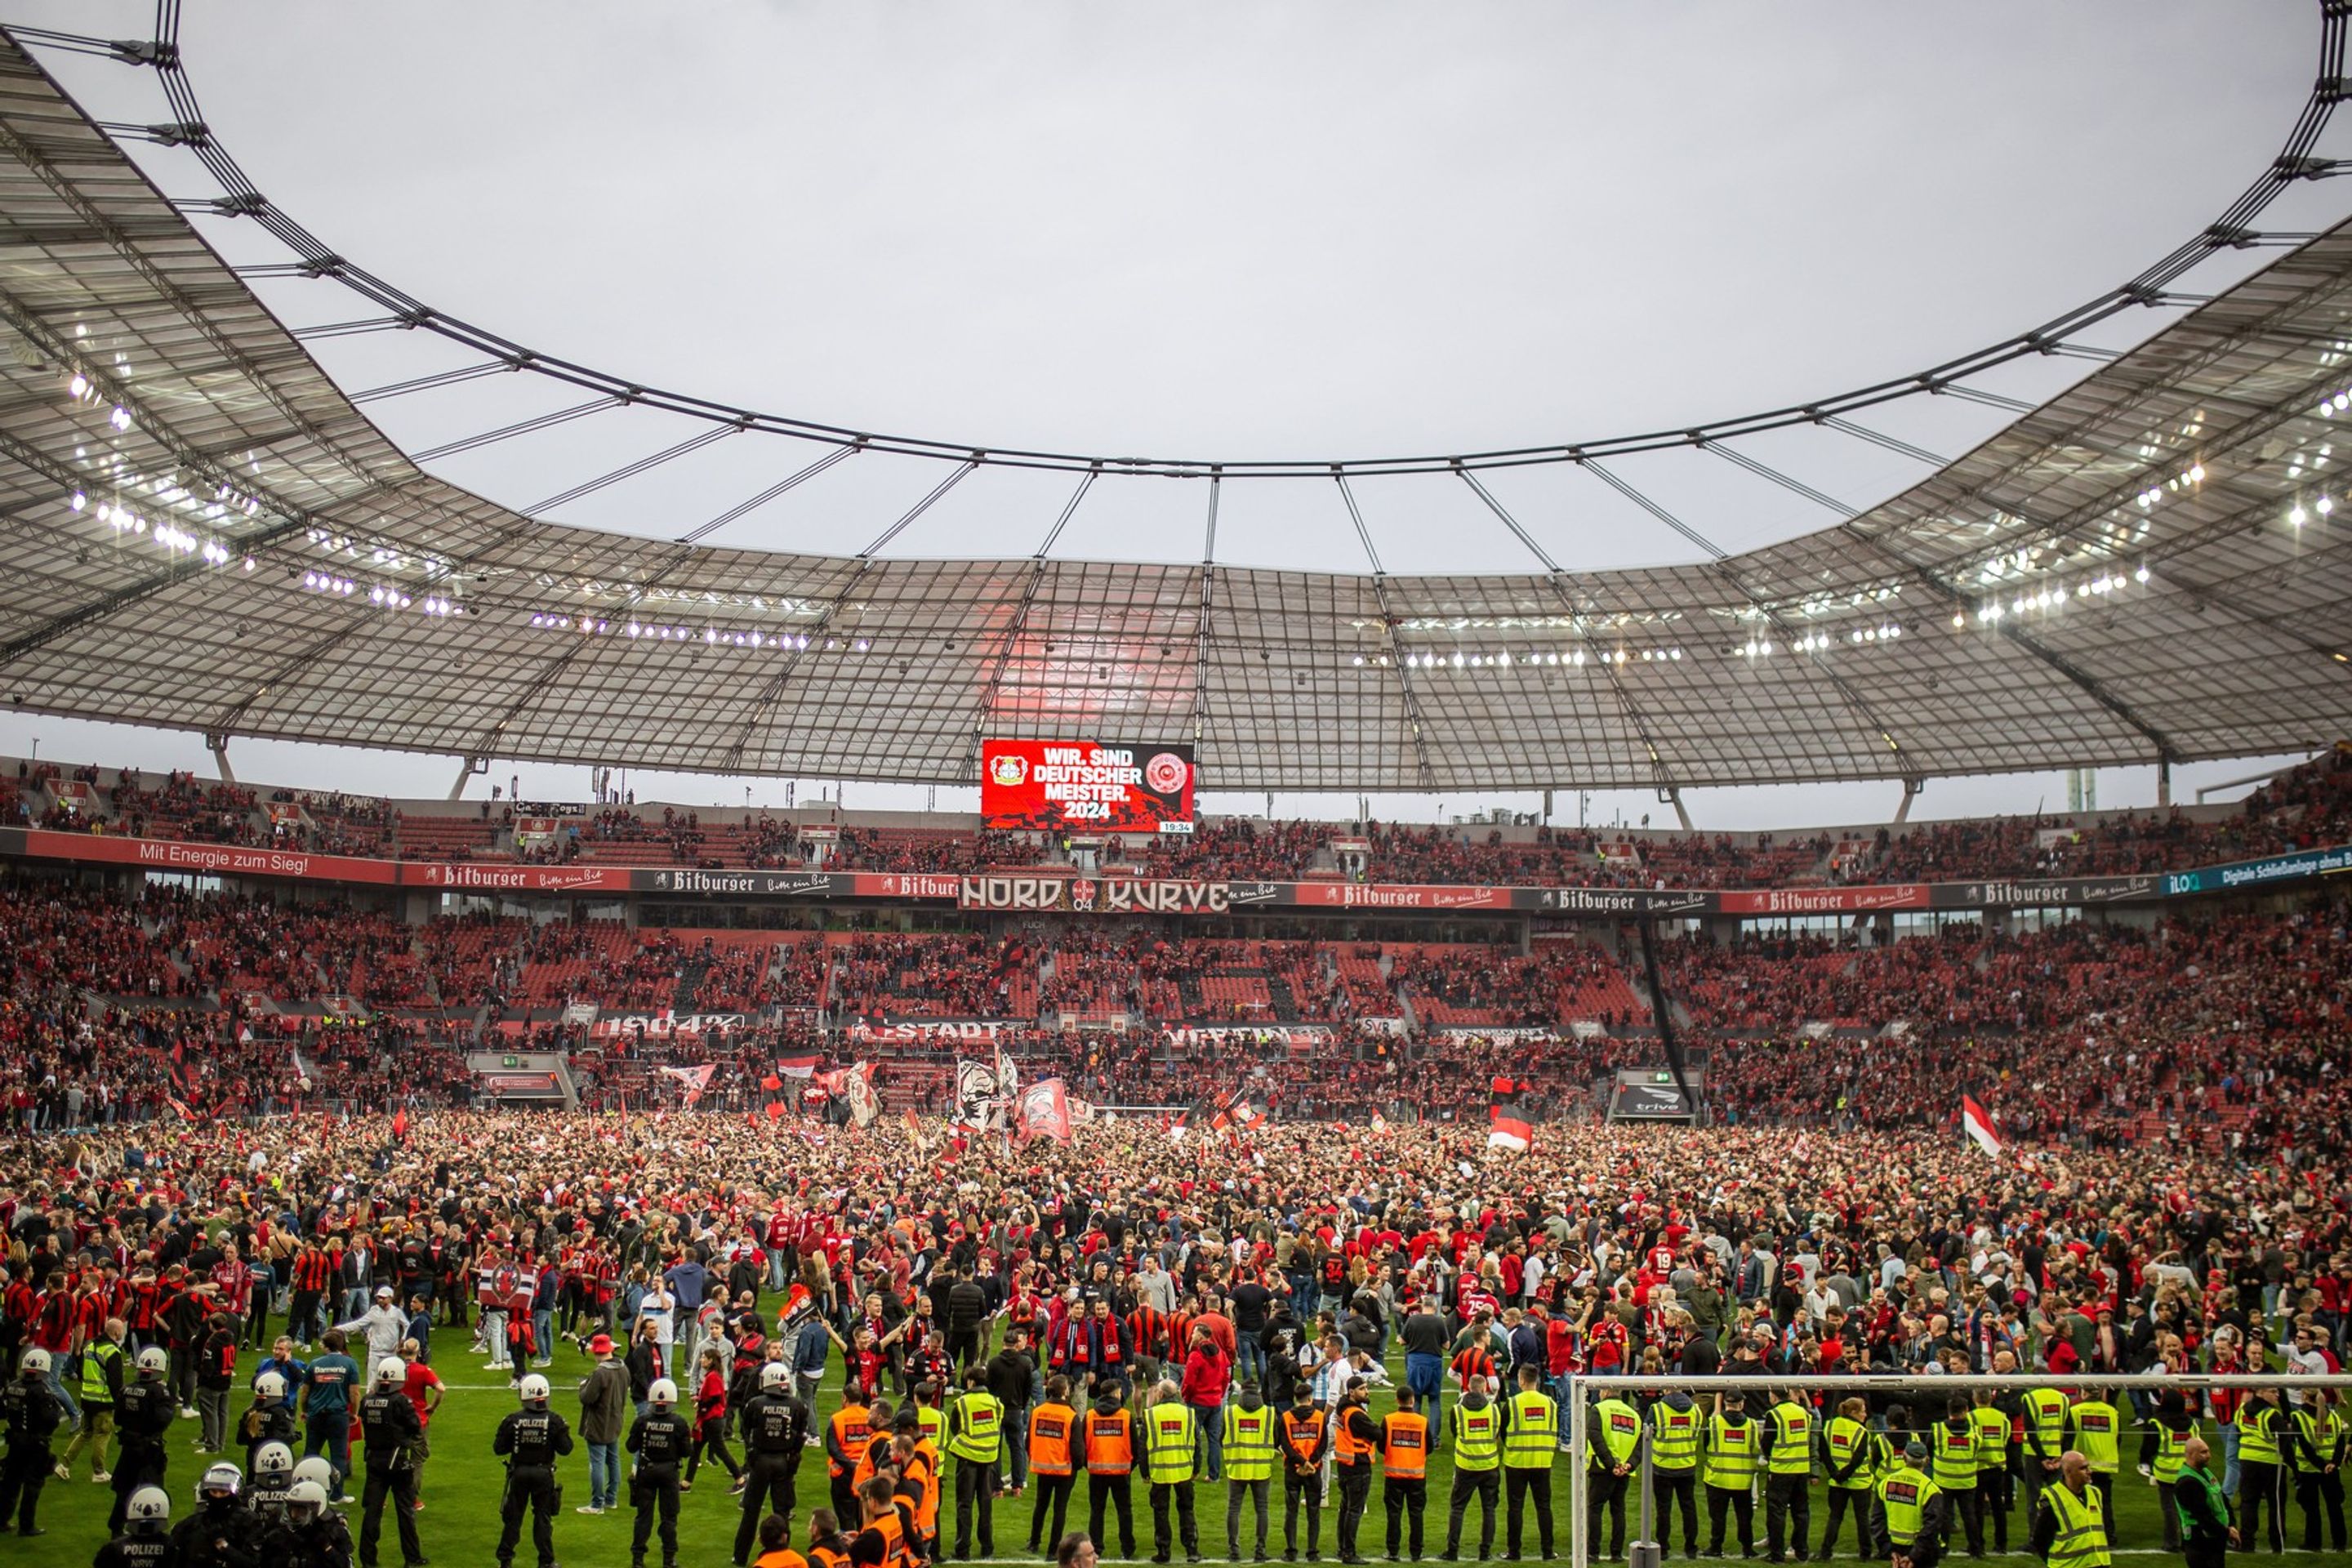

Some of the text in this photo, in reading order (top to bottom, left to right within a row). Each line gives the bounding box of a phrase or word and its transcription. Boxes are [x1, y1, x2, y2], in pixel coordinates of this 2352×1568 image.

[1044, 747, 1133, 766] WIR. SIND
[1034, 766, 1143, 785] DEUTSCHER
[1045, 784, 1131, 802] MEISTER.
[1064, 801, 1111, 819] 2024
[1164, 823, 1190, 831] 19:34
[140, 844, 309, 875] Mit Energie zum Sieg!
[443, 866, 526, 886] Bitburger
[584, 869, 604, 880] Bit
[672, 871, 755, 892] Bitburger
[2222, 869, 2255, 885] Digitale
[768, 878, 791, 891] Bitte
[811, 875, 831, 885] Bit
[2170, 873, 2201, 893] iLOQ
[961, 877, 1229, 912] NORD KURVE
[1344, 886, 1421, 905] Bitburger
[1558, 890, 1635, 909] Bitburger
[1984, 883, 2069, 902] Bitburger
[1073, 899, 1093, 911] 04
[1770, 892, 1843, 911] Bitburger
[1635, 1102, 1679, 1111] trive
[1655, 1253, 1671, 1268] 19
[1326, 1262, 1344, 1280] 34
[1468, 1300, 1484, 1316] 25
[123, 1387, 147, 1397] POLIZEI
[365, 1398, 389, 1407] POLIZEI
[763, 1405, 790, 1414] POLIZEI
[647, 1422, 675, 1432] POLIZEI
[261, 1459, 270, 1468] 14
[132, 1503, 160, 1513] 14 3
[123, 1544, 164, 1556] POLIZEI
